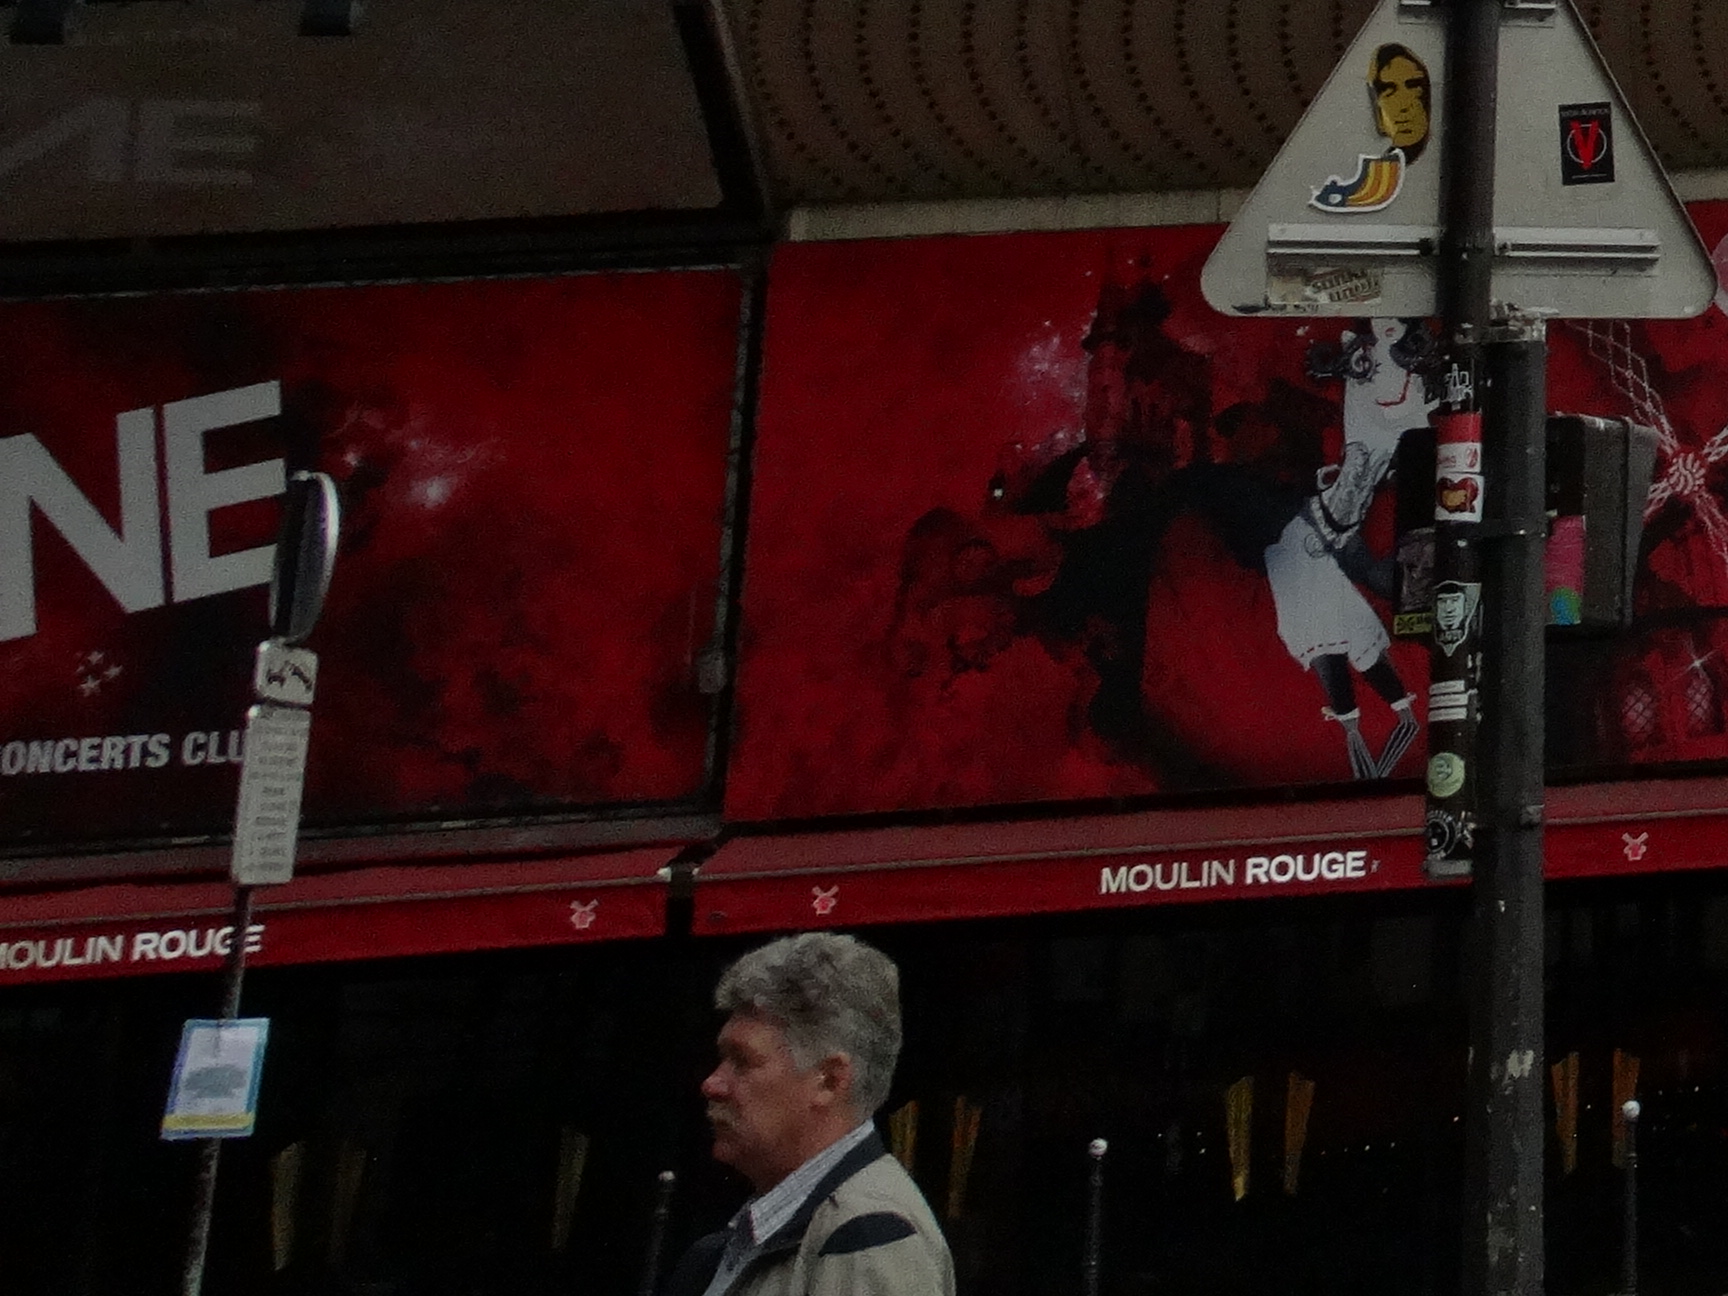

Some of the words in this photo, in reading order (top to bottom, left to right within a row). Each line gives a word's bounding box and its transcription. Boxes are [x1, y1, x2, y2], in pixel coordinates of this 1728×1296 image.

[0, 733, 170, 776] ONCERTS
[1100, 859, 1236, 895] MOULIN
[1245, 850, 1367, 885] ROUGE
